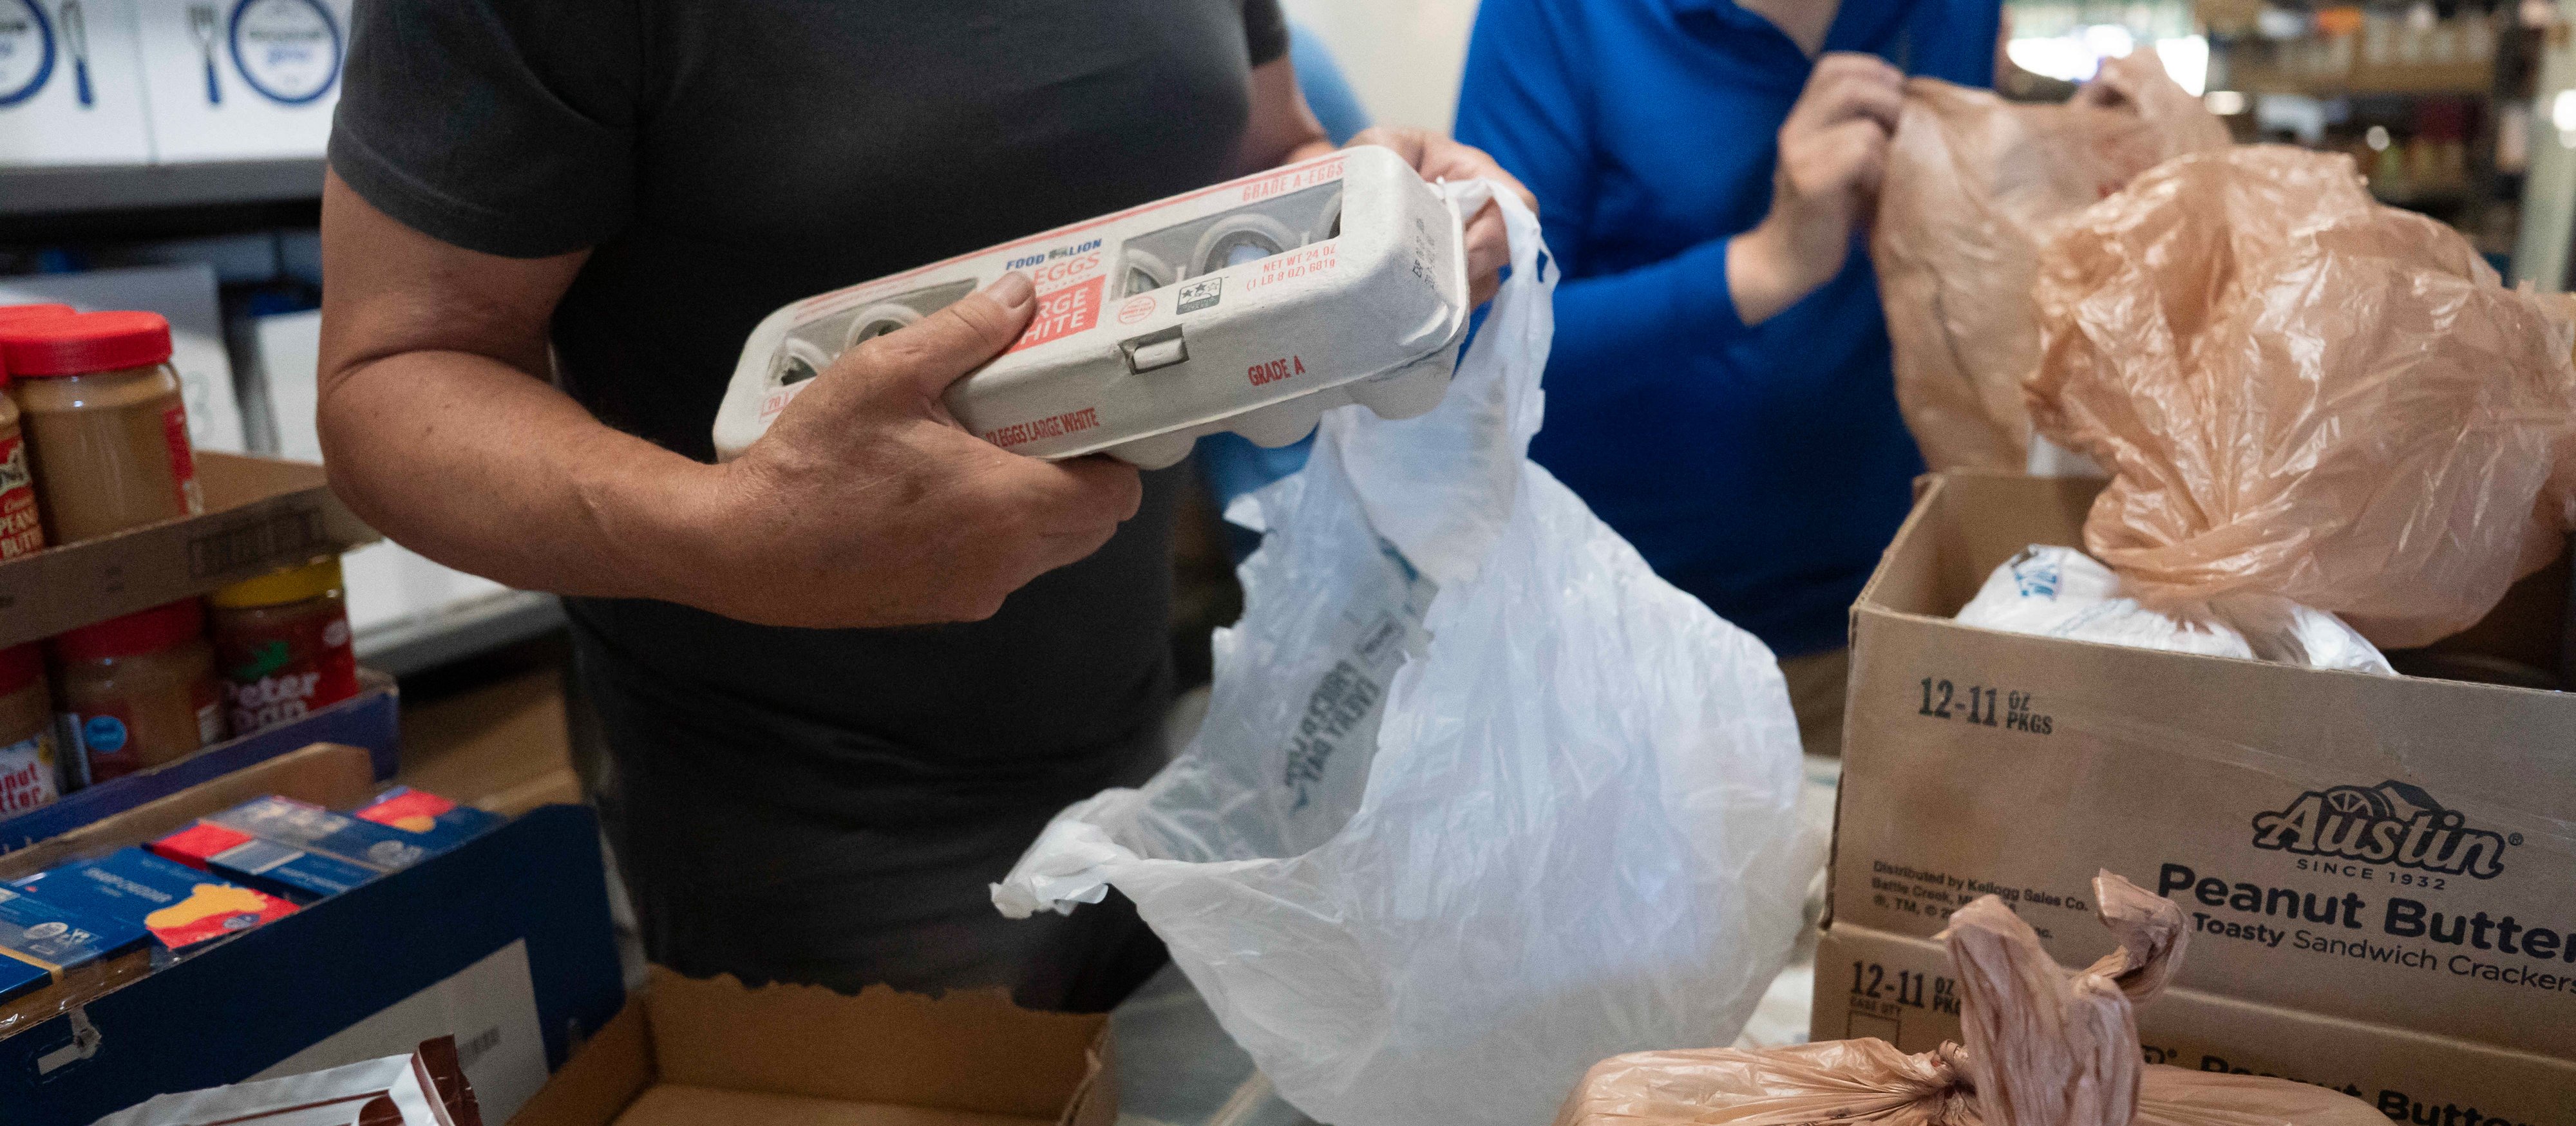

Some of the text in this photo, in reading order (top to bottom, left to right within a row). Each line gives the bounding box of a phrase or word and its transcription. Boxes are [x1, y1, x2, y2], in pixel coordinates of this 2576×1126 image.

[1243, 176, 1287, 202] GRADE
[1006, 238, 1103, 270] FOOD LION
[1033, 251, 1101, 286] EGGS
[1264, 243, 1338, 274] NET WT 24 OZ
[1247, 258, 1336, 292] (1 LB 8 OZ) 681g
[1038, 287, 1090, 319] RGE
[1020, 308, 1088, 345] HITE
[1248, 355, 1306, 386] GRADE A
[998, 424, 1027, 447] EGGS
[1025, 416, 1063, 442] LARGE
[1060, 407, 1100, 433] WHITE
[225, 672, 320, 708] eter
[1918, 677, 1997, 727] 12-11
[2008, 690, 2031, 711] OZ
[2006, 711, 2053, 735] PKGS
[2252, 789, 2505, 879] Austin
[1871, 876, 1909, 894] Battle
[1873, 859, 2088, 911] Distributed by Kellogg Sales Co.
[2297, 858, 2446, 890] SINCE 1932
[2158, 863, 2365, 929] Peanut
[2192, 912, 2286, 948] Toasty
[2293, 930, 2438, 971] Sandwich
[1850, 961, 1925, 1009] 12-11
[1935, 975, 1955, 995] OZ
